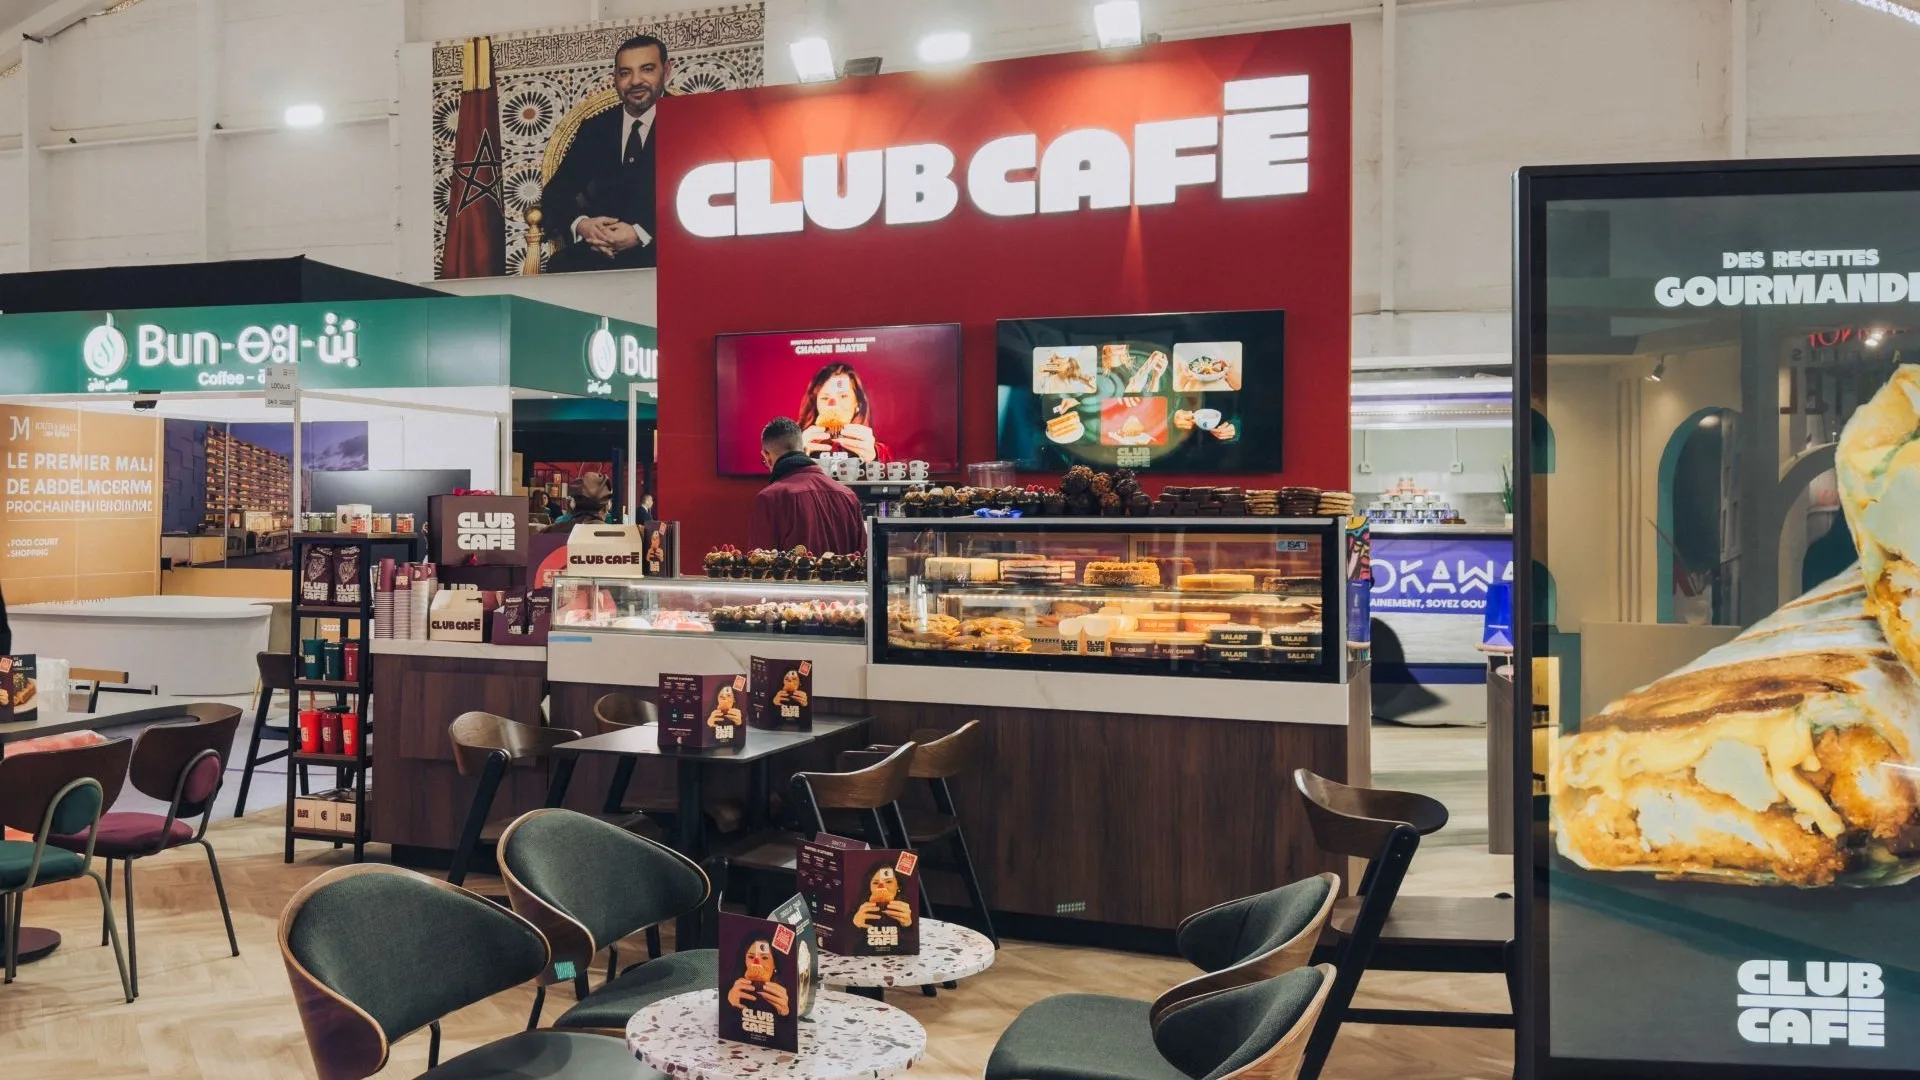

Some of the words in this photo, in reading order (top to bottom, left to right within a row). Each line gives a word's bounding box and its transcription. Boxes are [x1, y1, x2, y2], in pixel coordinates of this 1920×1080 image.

[676, 143, 958, 238] CLUB
[1723, 251, 1765, 270] DES
[1773, 249, 1880, 268] RECETTES
[198, 371, 245, 386] Coffee
[7, 452, 28, 469] LE
[34, 453, 110, 471] PREMIER
[7, 478, 29, 495] DE
[457, 512, 515, 528] CLUB
[11, 538, 32, 547] FOOD
[34, 538, 59, 546] COURT
[570, 555, 604, 565] CLUB
[303, 582, 328, 591] CLUB
[1426, 599, 1459, 608] SOYEZ
[431, 620, 455, 631] CLUB
[867, 925, 898, 935] CLUB
[1737, 959, 1885, 998] CLUB
[742, 1008, 775, 1022] CLUB
